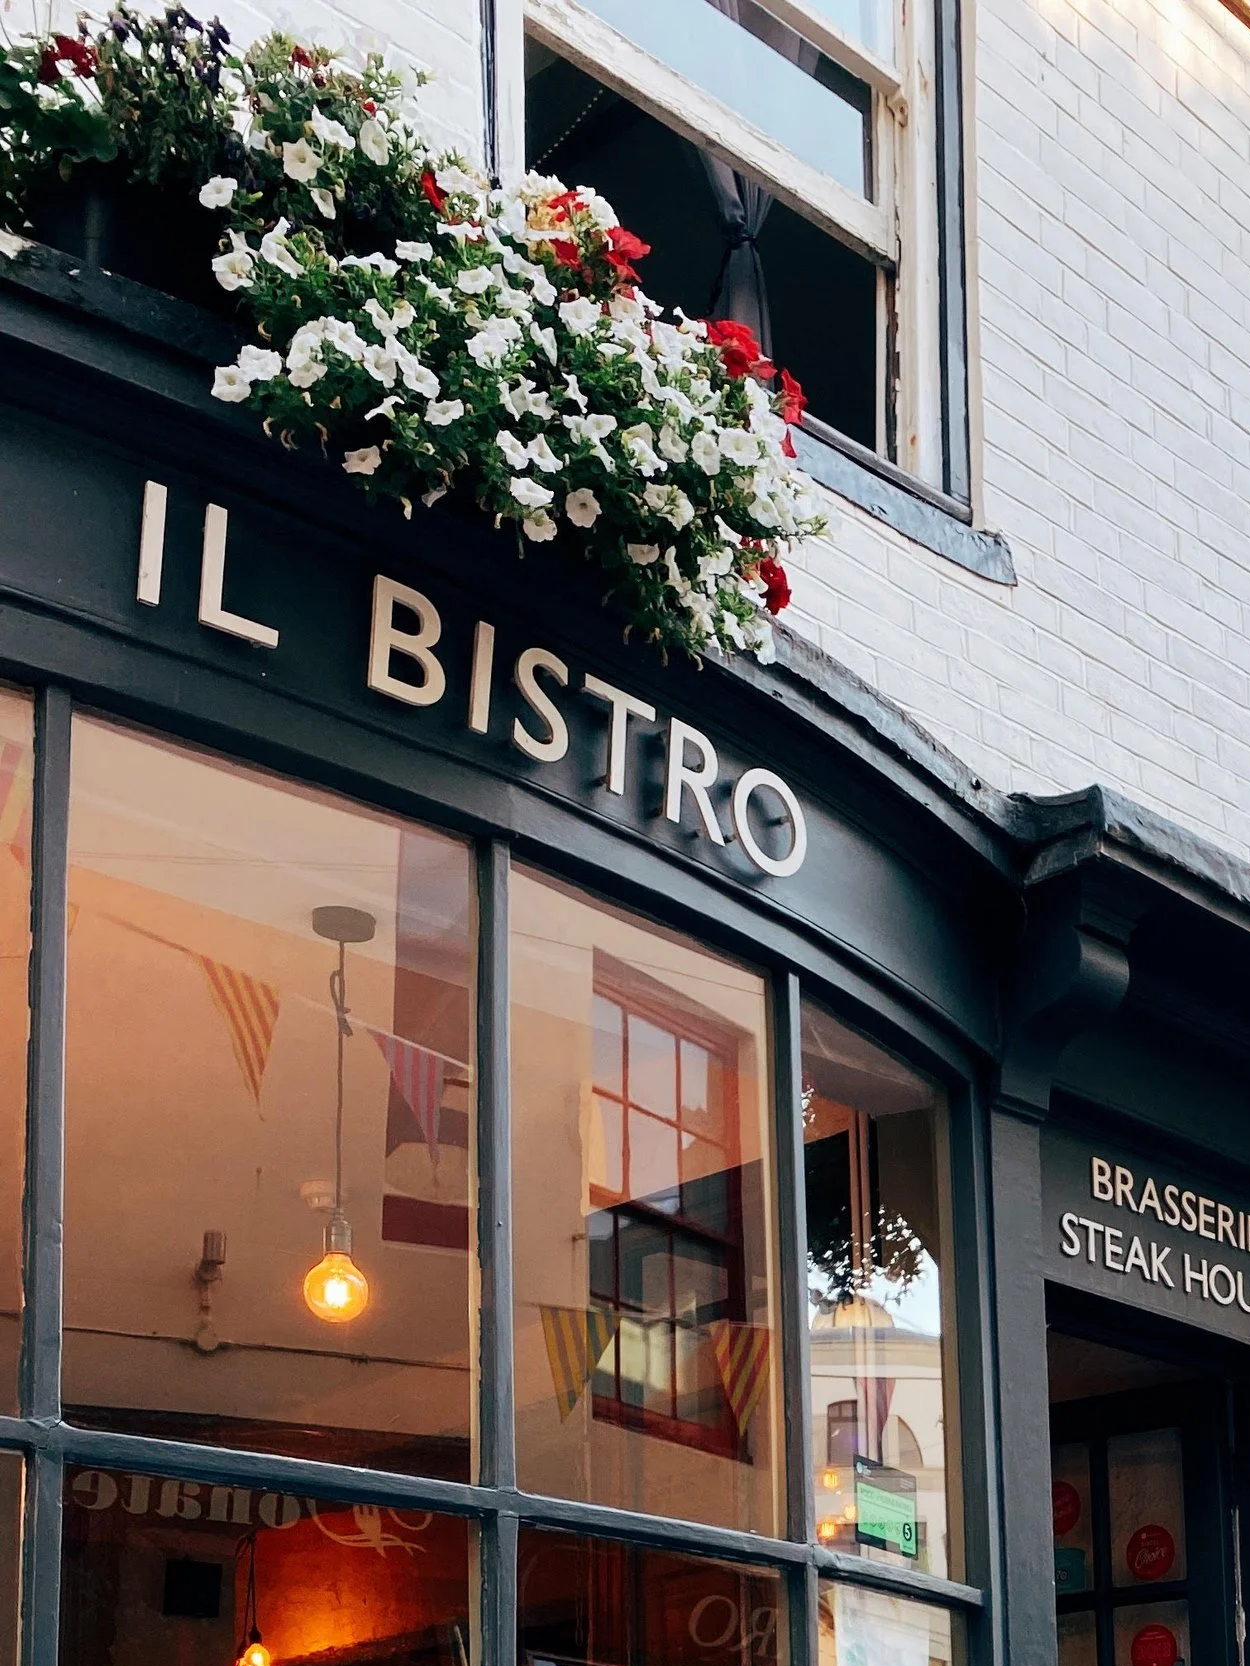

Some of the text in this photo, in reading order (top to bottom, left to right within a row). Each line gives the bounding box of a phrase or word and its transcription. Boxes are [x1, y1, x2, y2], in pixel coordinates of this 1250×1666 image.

[137, 479, 807, 878] IL BISTRO
[1060, 1212, 1175, 1288] STEAK
[904, 1524, 911, 1541] 5
